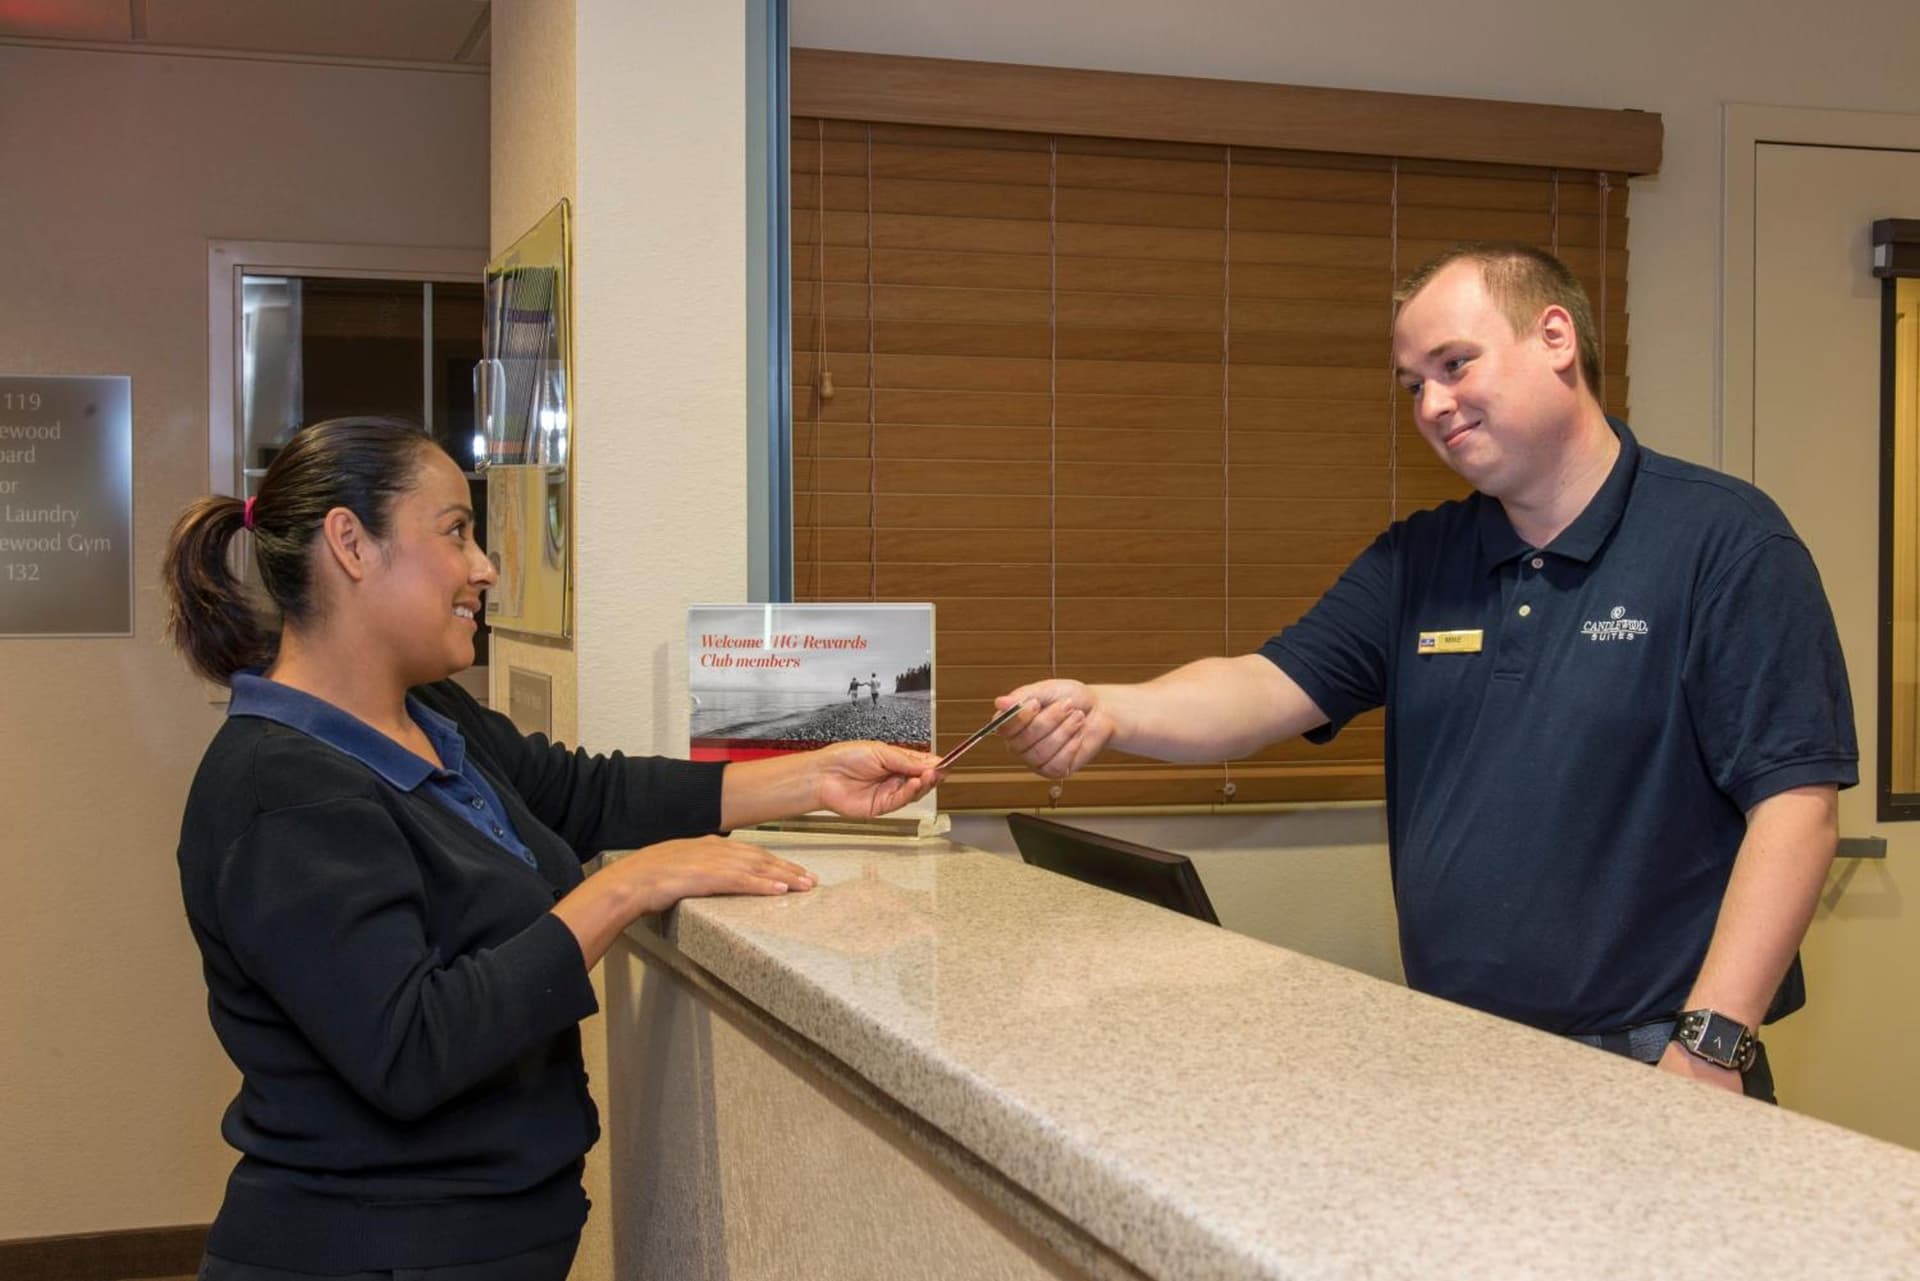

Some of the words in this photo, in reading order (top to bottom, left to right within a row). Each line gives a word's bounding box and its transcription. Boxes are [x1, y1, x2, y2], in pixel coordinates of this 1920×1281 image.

[4, 392, 41, 410] 119
[0, 421, 61, 440] ewood
[5, 504, 80, 528] Laundry
[0, 532, 61, 551] ewood
[67, 533, 112, 558] Gym
[5, 564, 40, 581] 132
[701, 634, 763, 649] Welcome
[803, 634, 868, 649] Rewards
[1591, 632, 1634, 641] SUITES
[700, 653, 733, 668] Club
[735, 653, 801, 668] members
